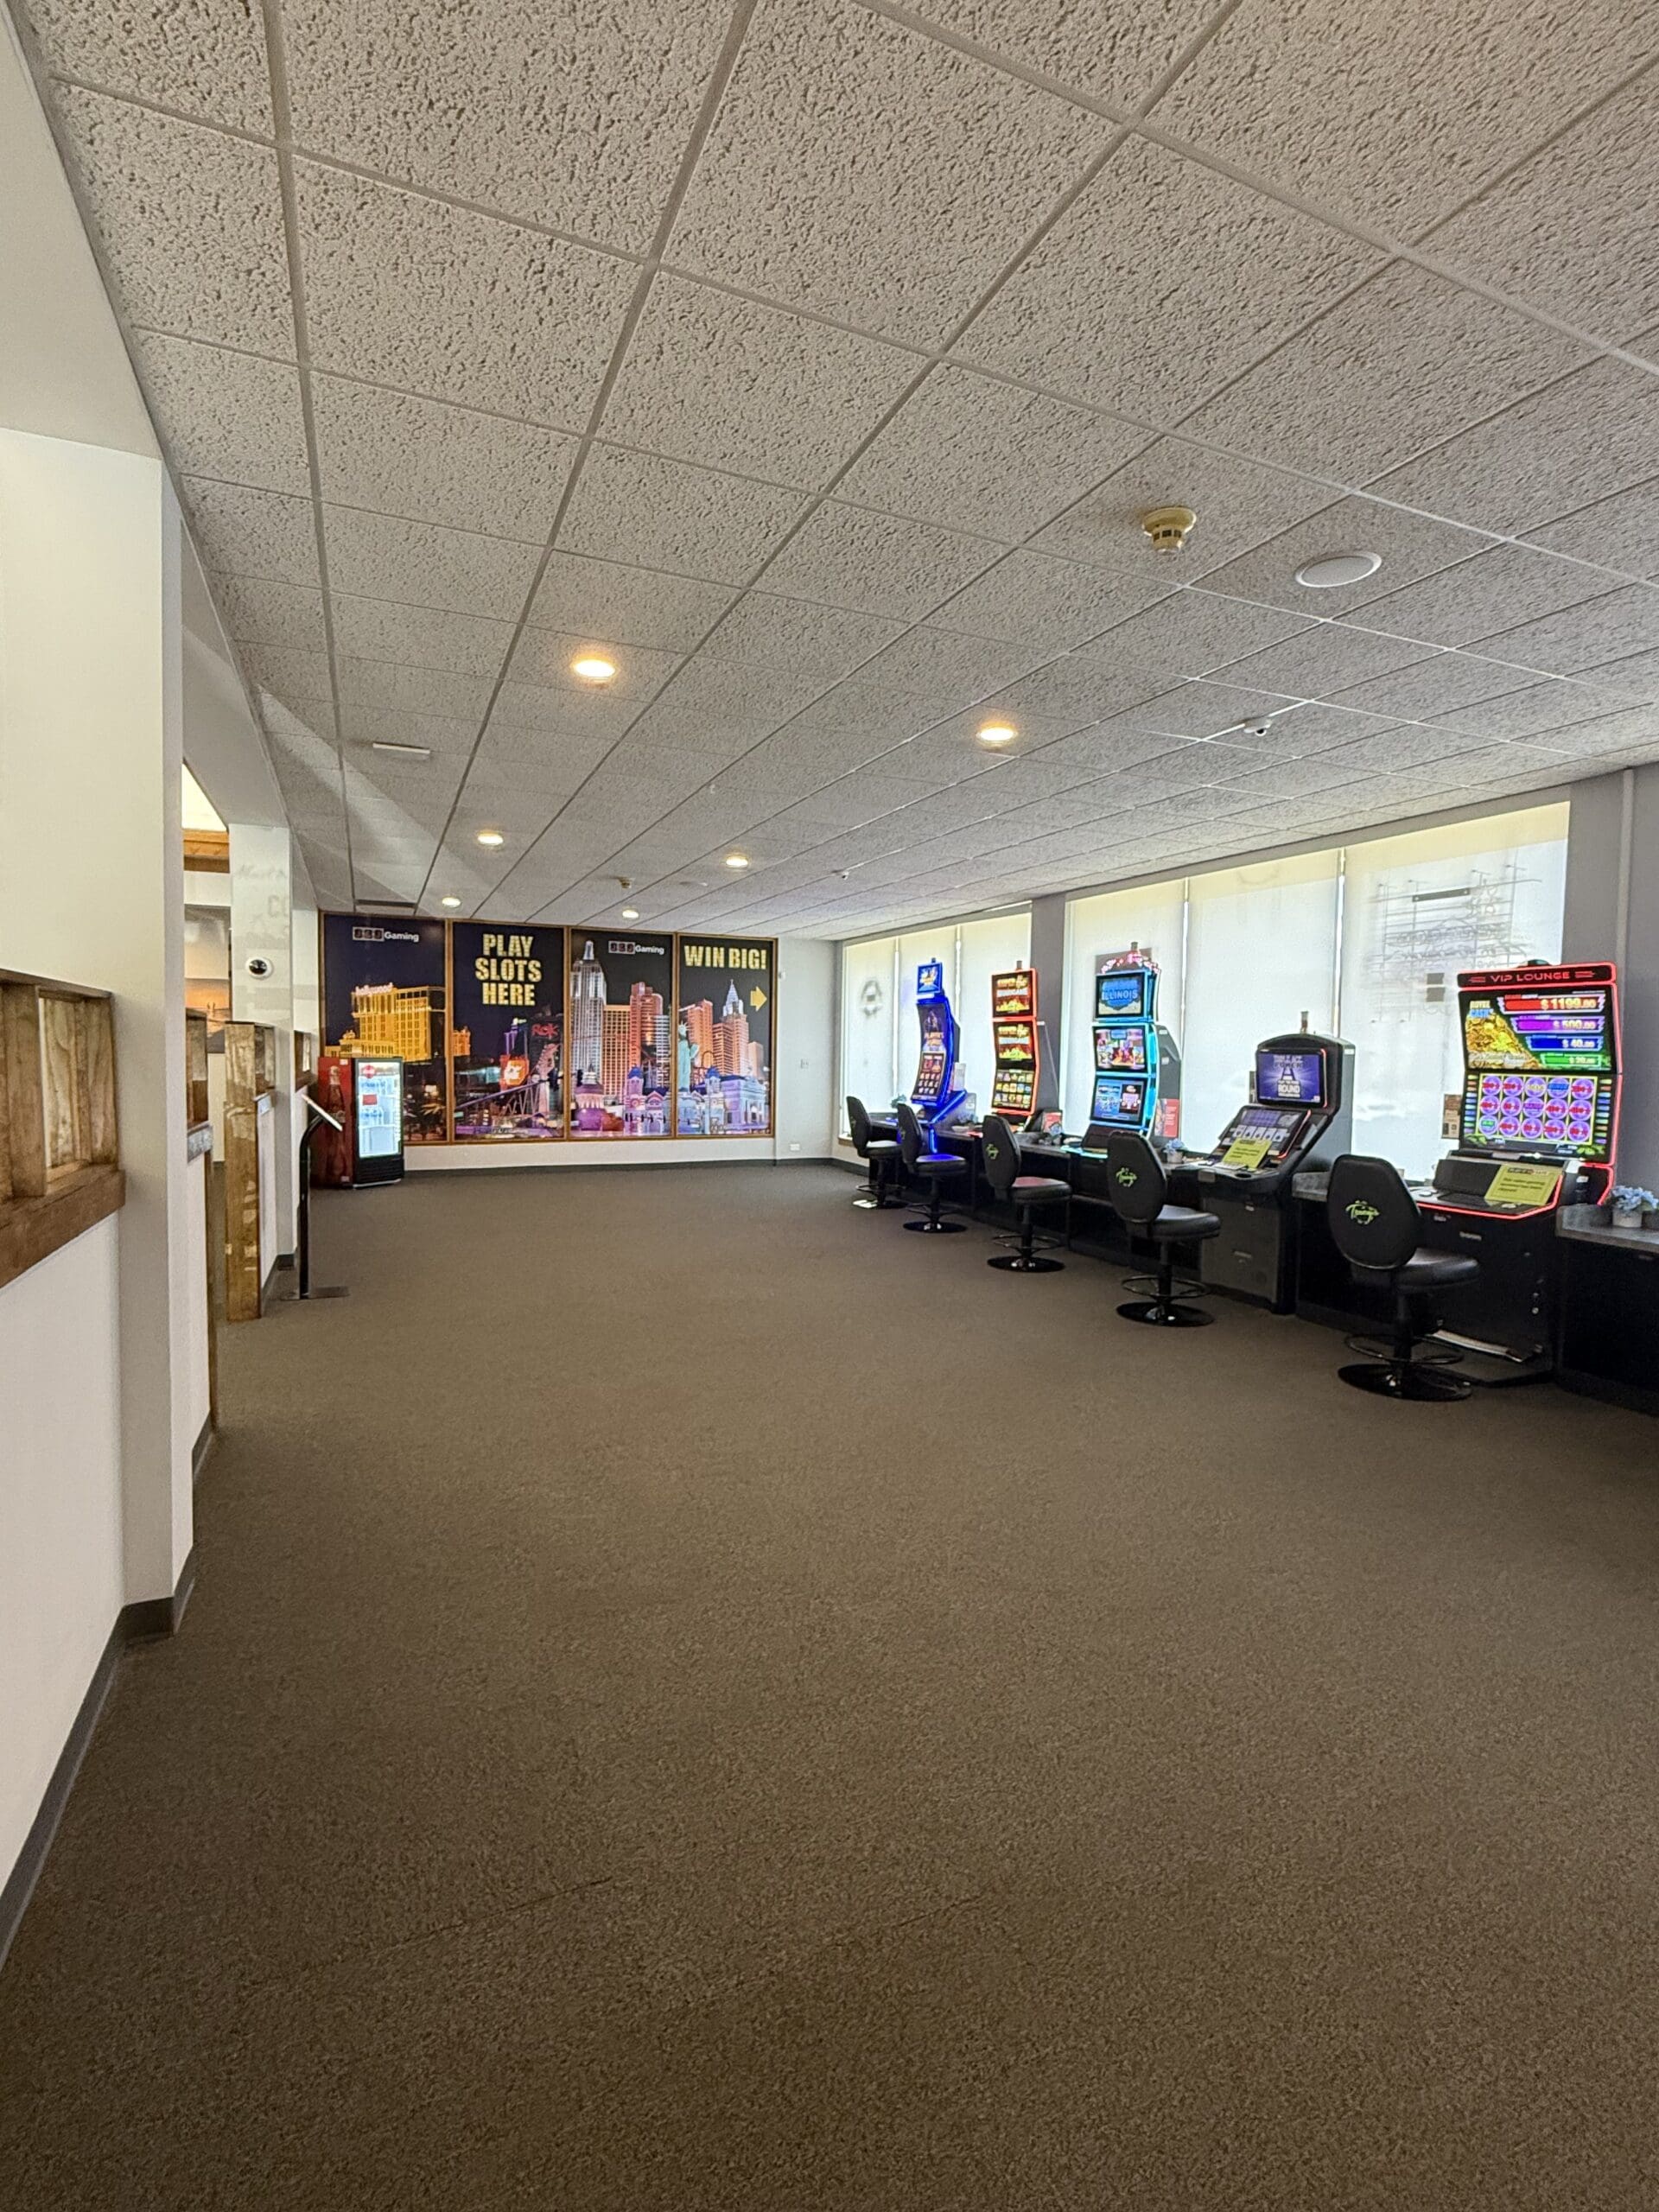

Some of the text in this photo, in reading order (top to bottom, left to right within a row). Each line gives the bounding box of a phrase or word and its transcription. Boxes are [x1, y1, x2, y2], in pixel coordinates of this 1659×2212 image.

[385, 931, 419, 943] Gaming
[482, 933, 534, 957] PLAY
[635, 944, 664, 956] Gaming
[683, 945, 767, 969] WIN BIG!
[474, 957, 542, 982] SLOTS
[1491, 971, 1571, 982] VIP LOUNGE
[482, 982, 536, 1006] HERE
[1102, 989, 1139, 1001] ILLINOIS
[1278, 1084, 1300, 1094] ROUND
